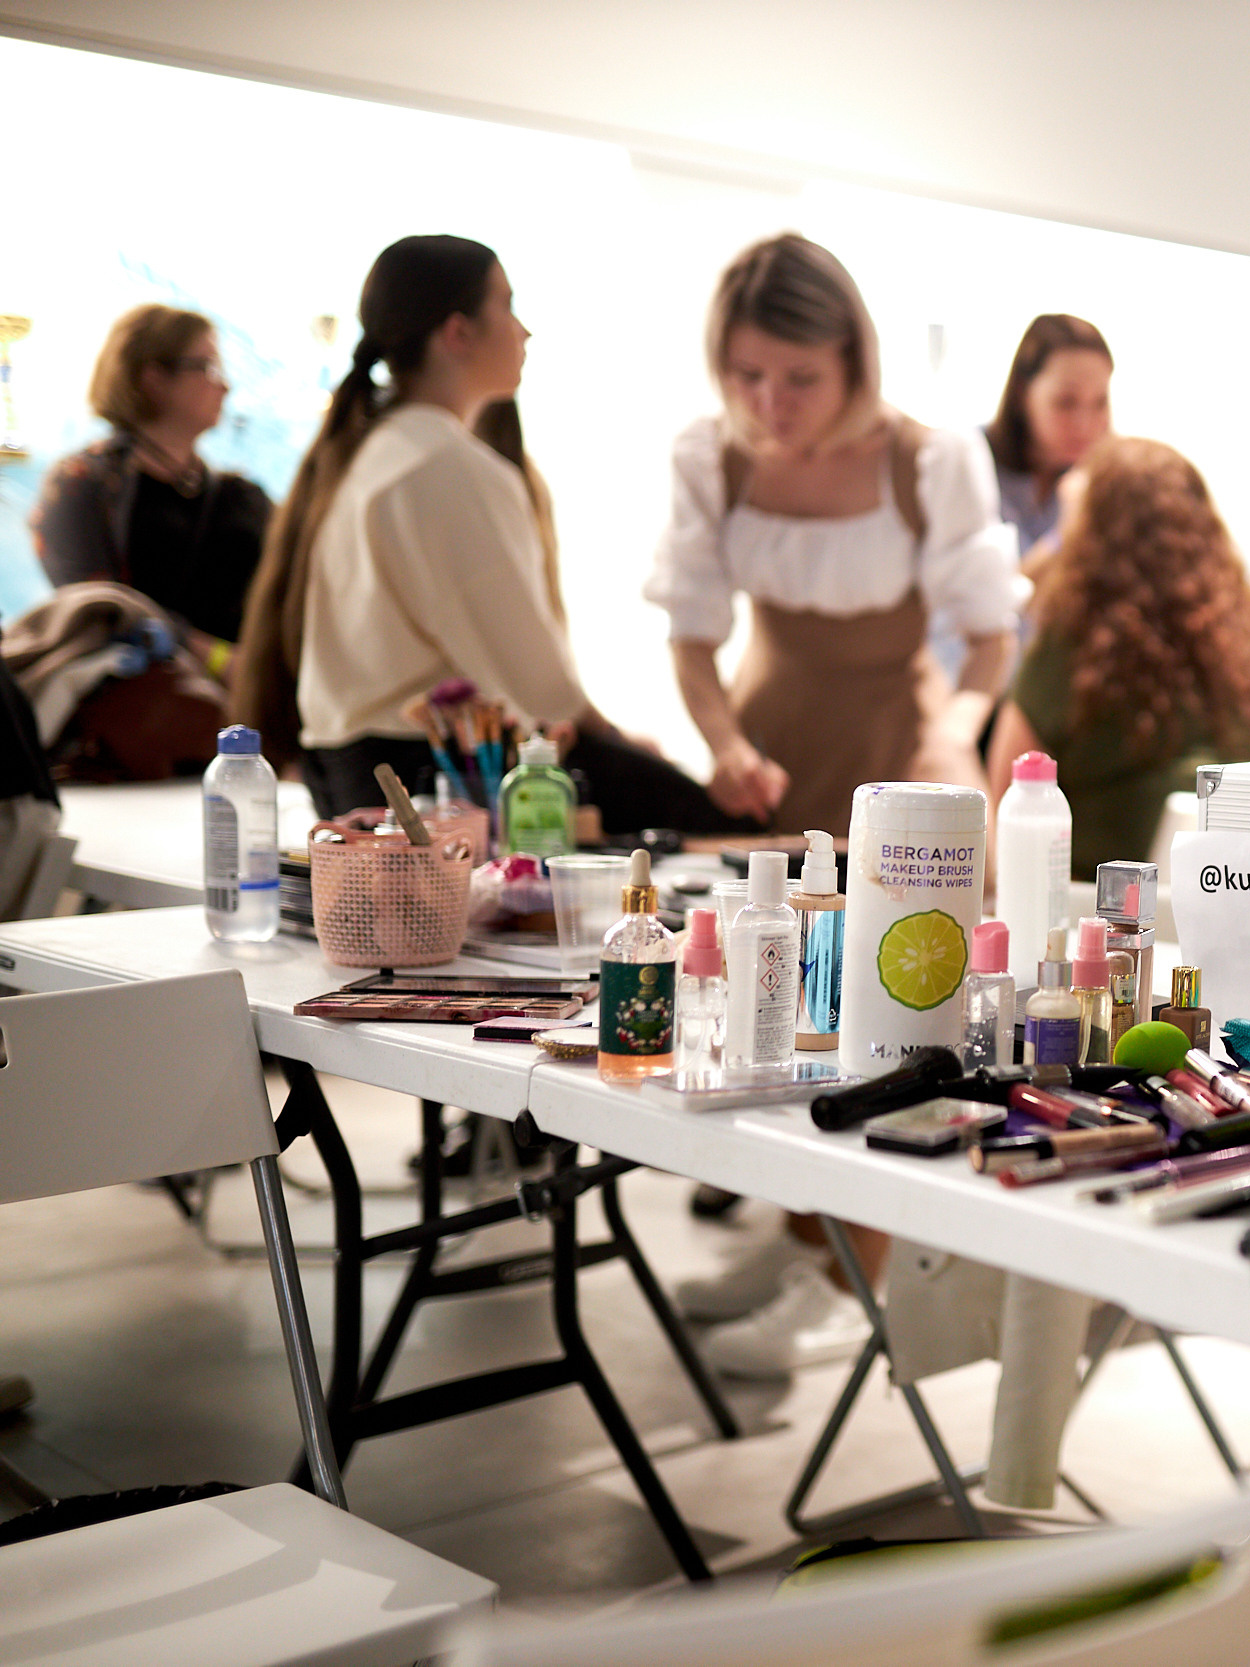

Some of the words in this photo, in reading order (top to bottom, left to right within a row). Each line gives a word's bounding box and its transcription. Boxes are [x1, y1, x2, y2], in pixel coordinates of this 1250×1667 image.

[881, 844, 975, 861] BERGAMOT
[880, 862, 935, 875] MAKEUP
[938, 865, 974, 876] BRUSH
[879, 875, 942, 888] CLEANSING
[945, 878, 973, 888] WIPES
